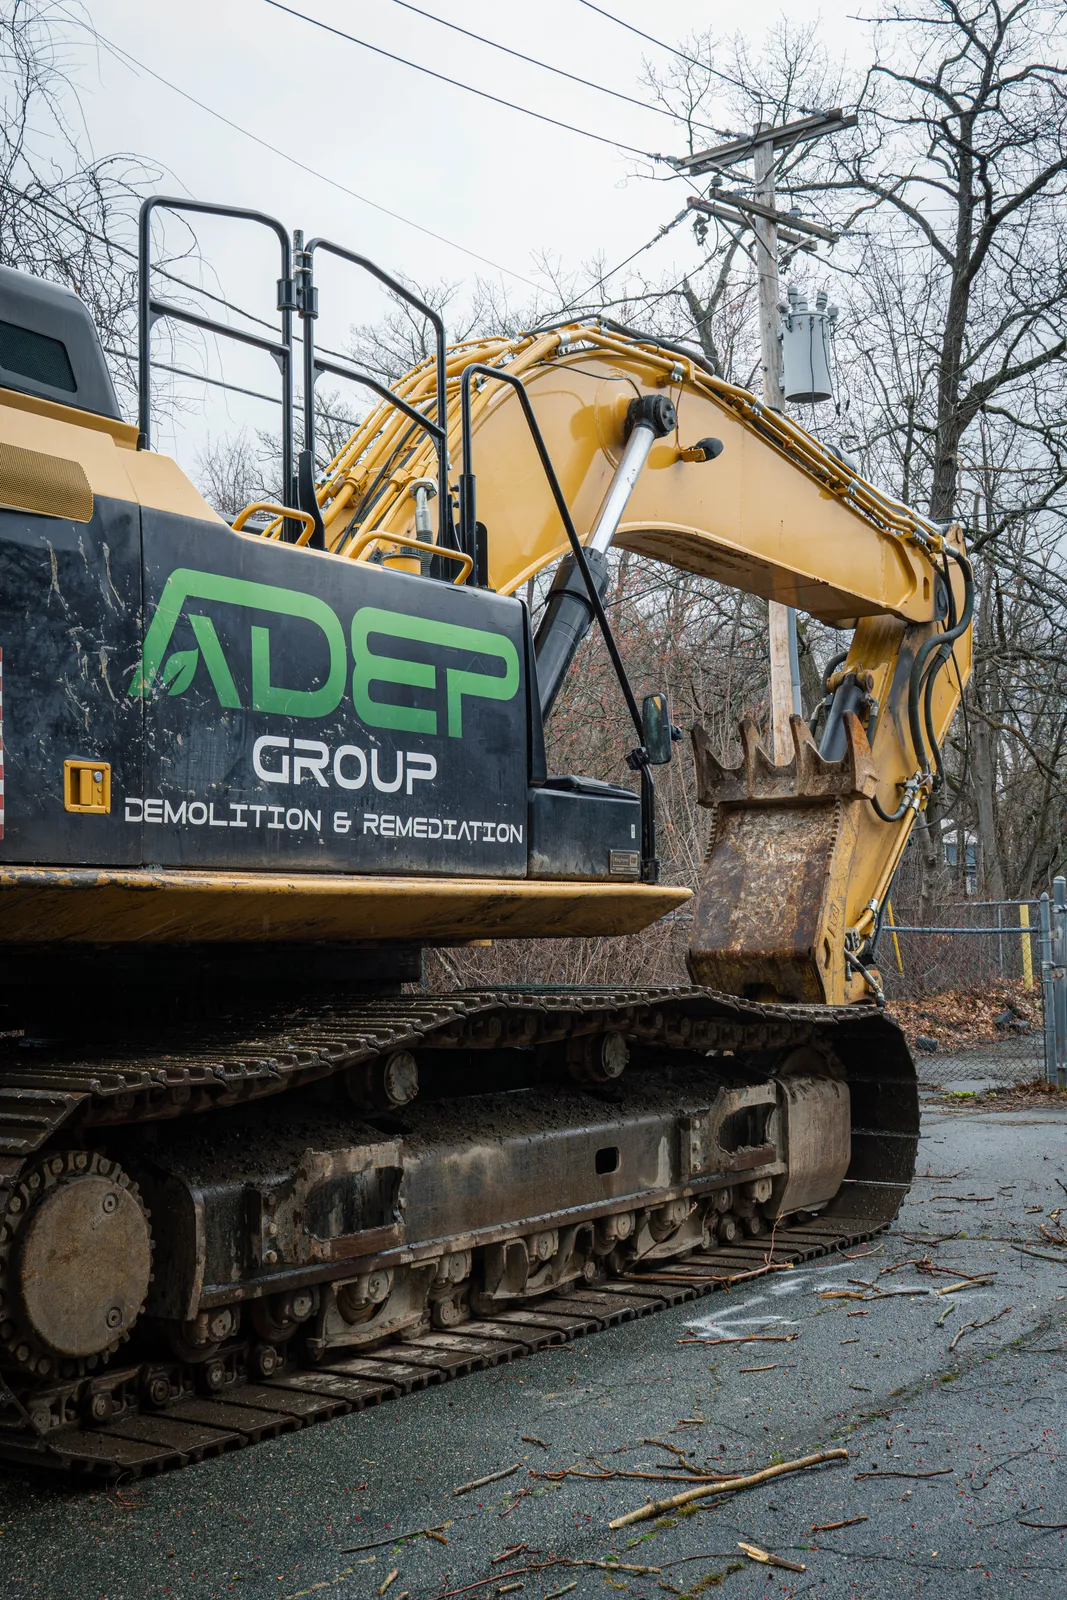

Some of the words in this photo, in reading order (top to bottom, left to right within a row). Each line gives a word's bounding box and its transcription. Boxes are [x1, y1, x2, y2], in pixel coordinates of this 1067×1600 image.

[127, 567, 520, 738] ADEP
[252, 735, 438, 795] GROUP
[124, 797, 322, 832] DEMOLITION
[333, 811, 352, 834] &
[363, 813, 524, 844] REMEDIATION
